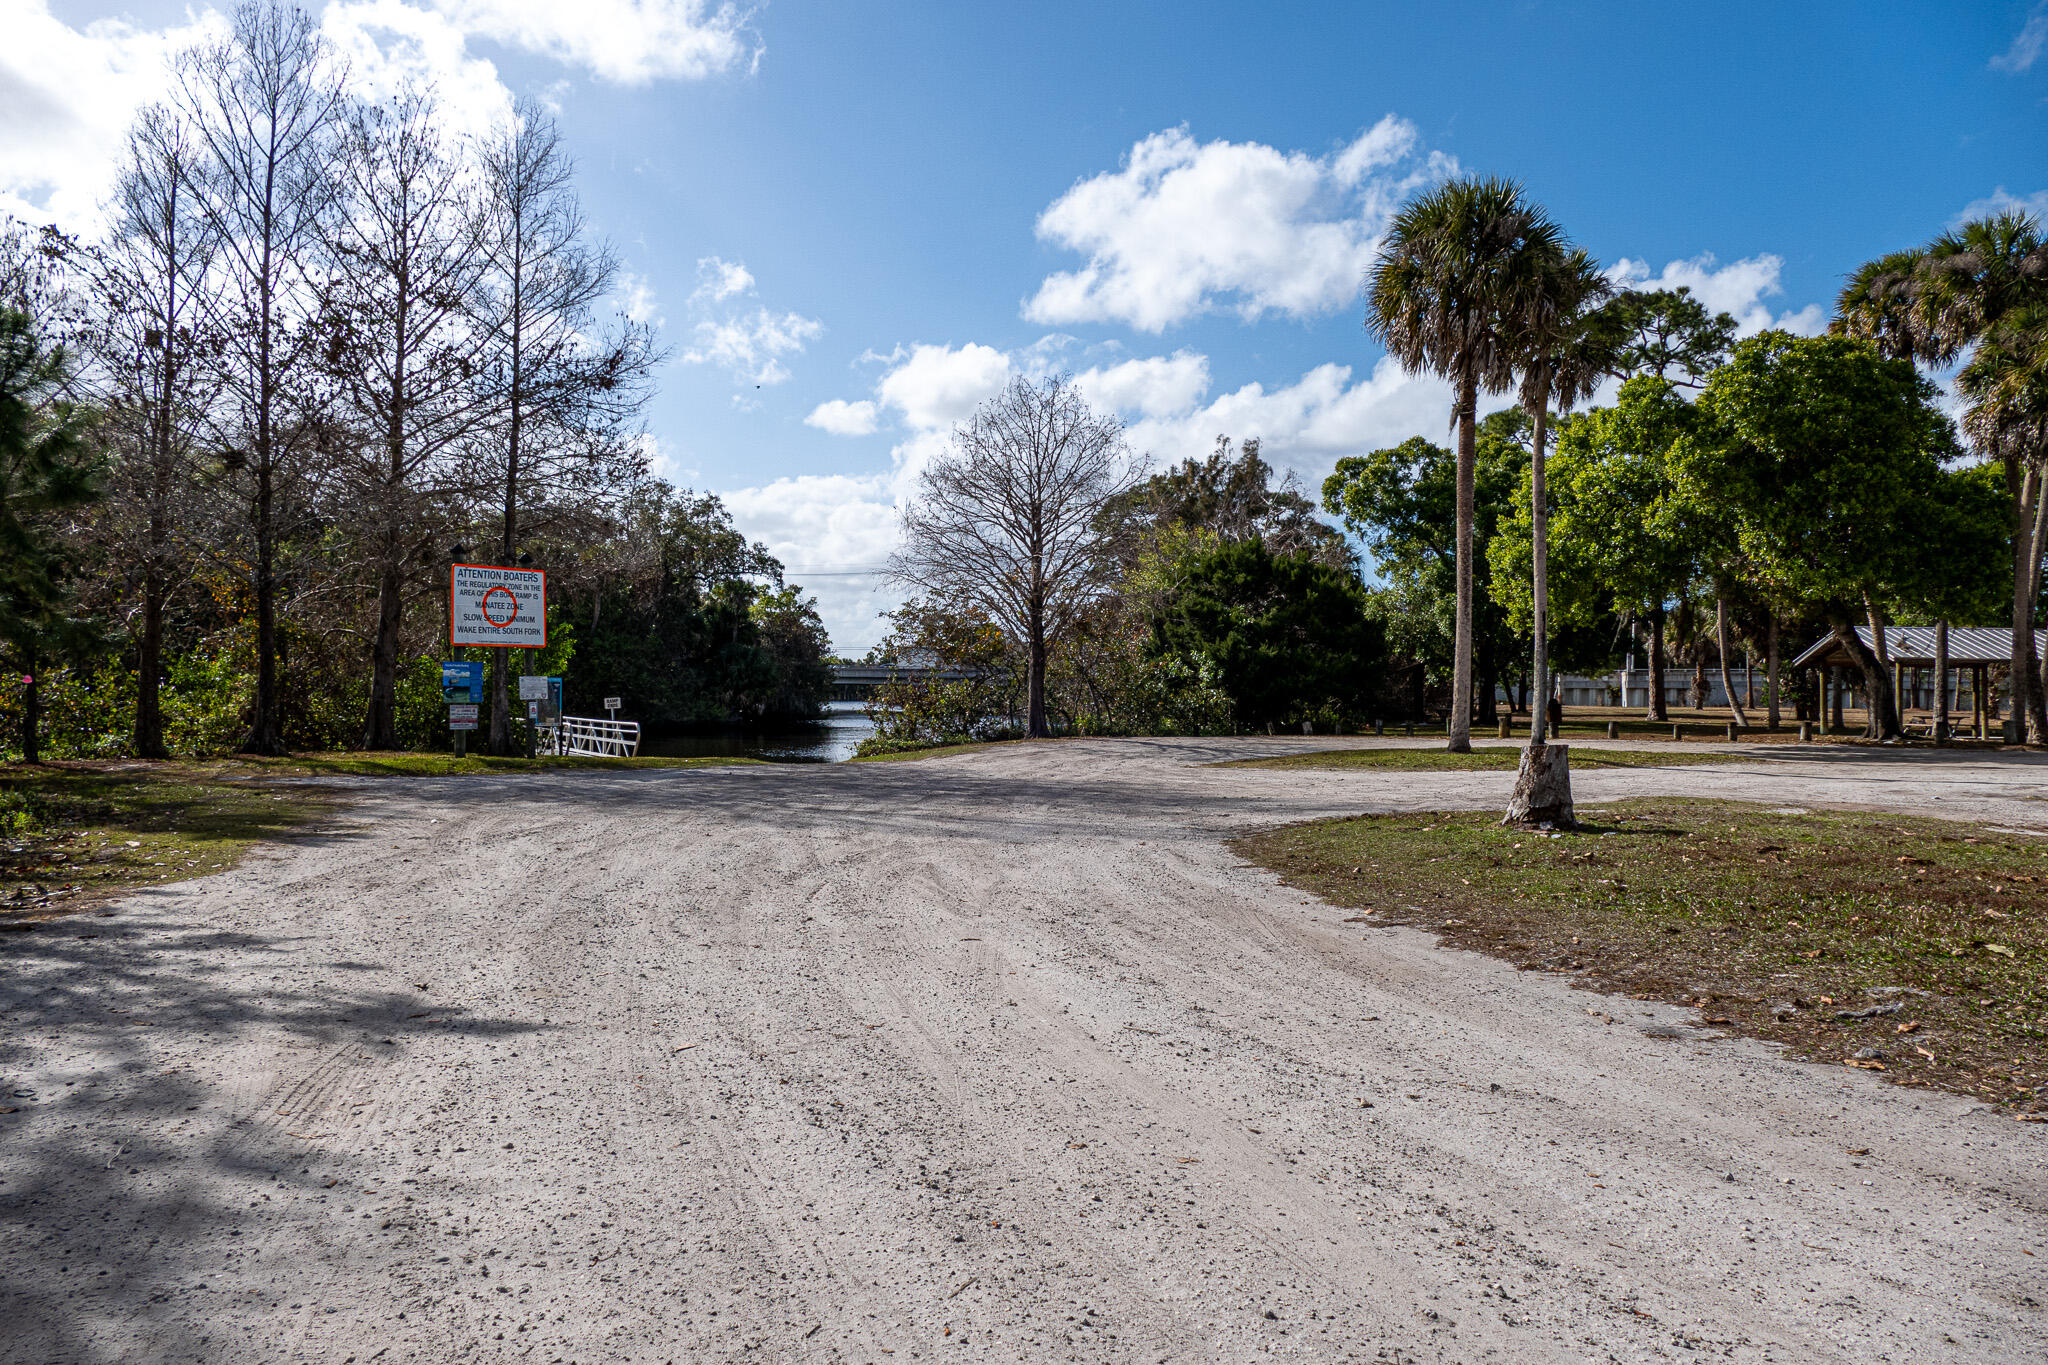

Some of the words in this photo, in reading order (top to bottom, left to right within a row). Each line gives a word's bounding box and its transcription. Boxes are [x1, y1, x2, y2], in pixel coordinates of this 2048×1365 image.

[458, 568, 501, 580] ATTENTION
[504, 572, 538, 582] BOATERS
[475, 601, 505, 609] MANATEE
